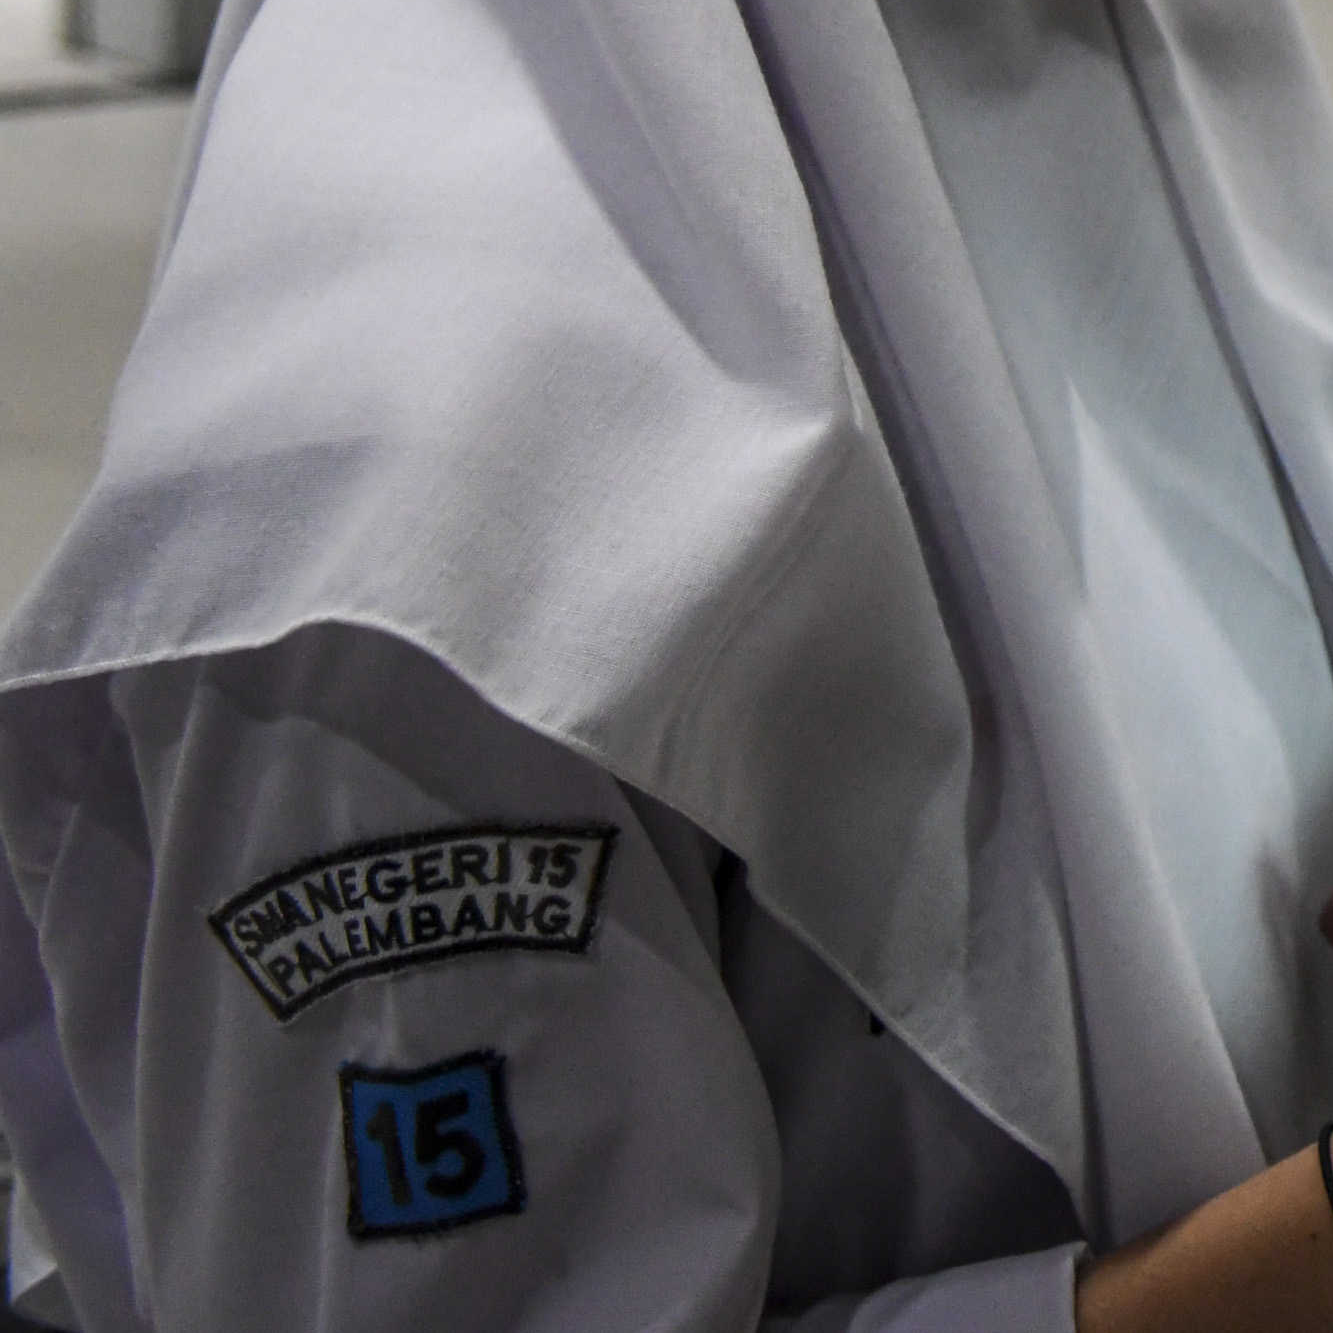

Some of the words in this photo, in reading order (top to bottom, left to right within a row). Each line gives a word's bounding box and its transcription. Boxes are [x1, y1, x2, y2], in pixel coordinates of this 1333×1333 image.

[234, 891, 311, 957] SMA
[303, 843, 512, 916] NEGERI
[528, 844, 582, 888] 15
[267, 893, 571, 997] PALEMBANG
[365, 1092, 485, 1207] 15
